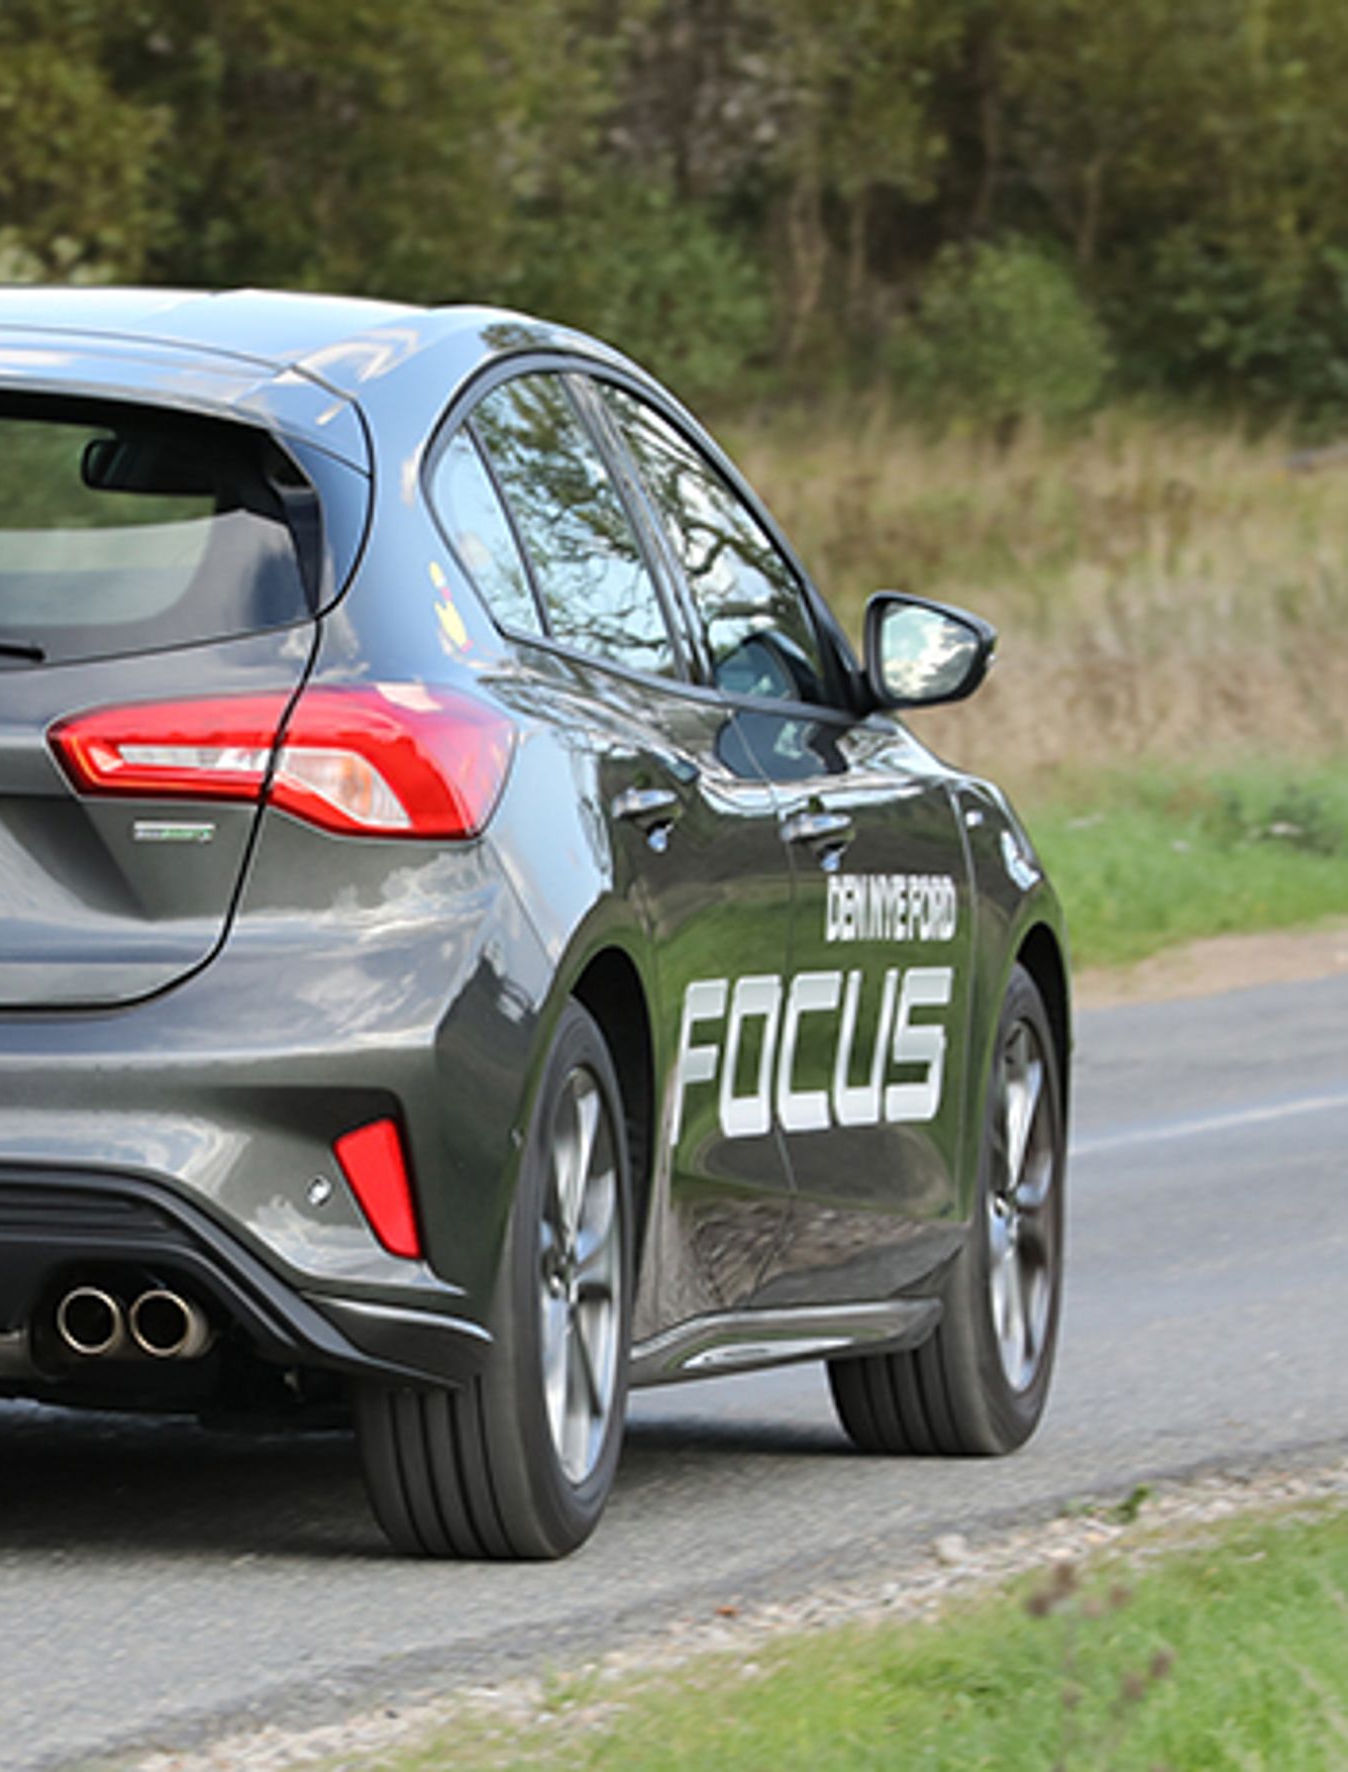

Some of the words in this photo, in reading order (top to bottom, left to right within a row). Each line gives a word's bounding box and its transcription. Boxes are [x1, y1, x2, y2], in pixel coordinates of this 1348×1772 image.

[826, 874, 867, 941] DEN
[869, 874, 907, 940] NYE
[908, 874, 956, 941] FORD
[669, 967, 954, 1146] FOCUS
